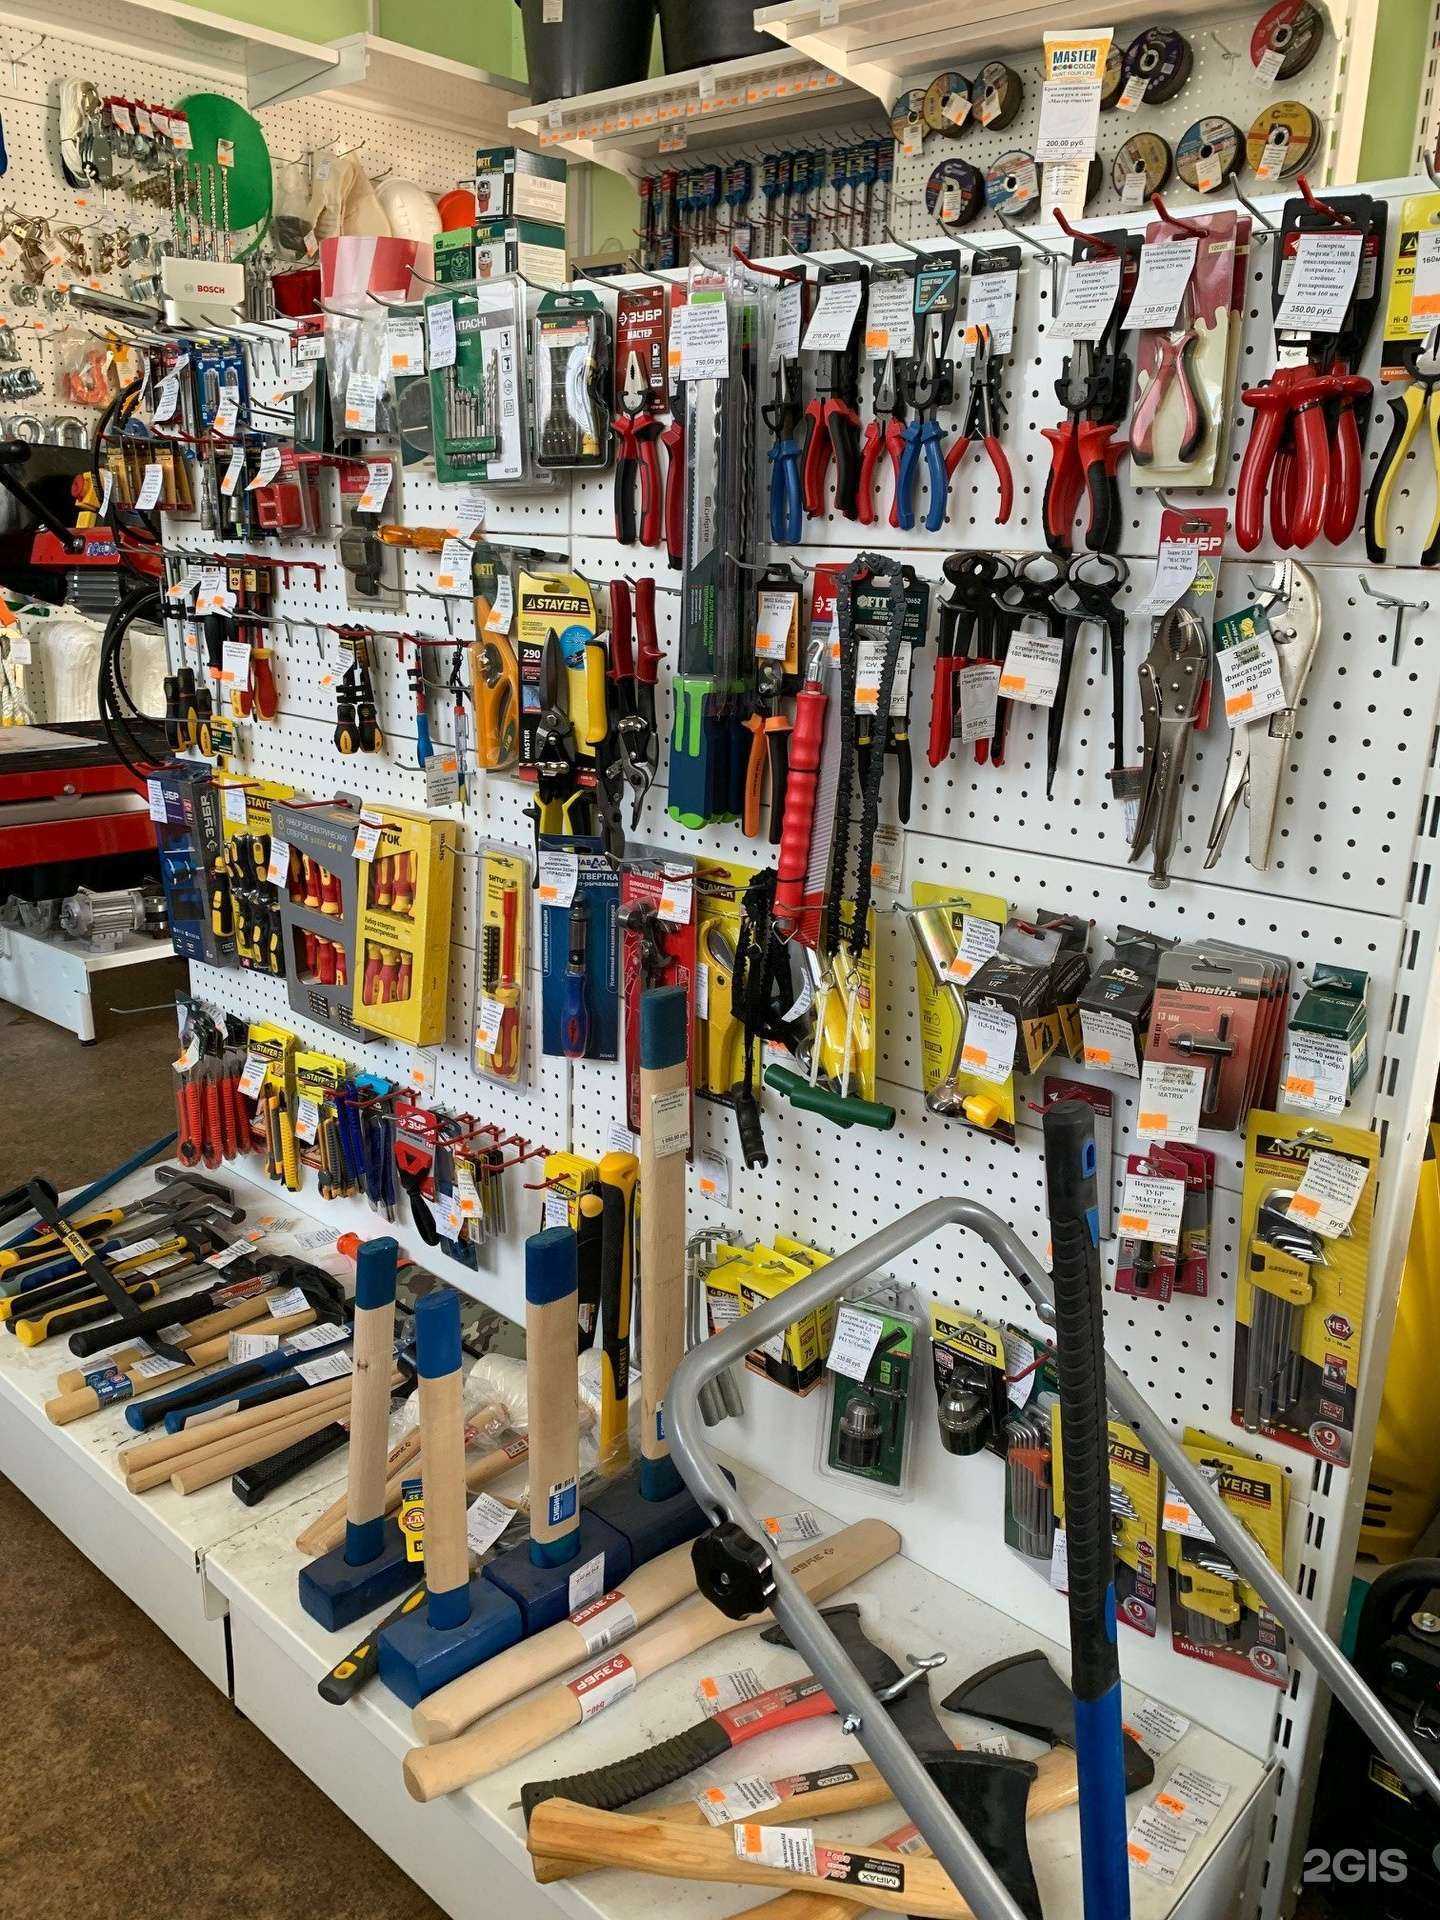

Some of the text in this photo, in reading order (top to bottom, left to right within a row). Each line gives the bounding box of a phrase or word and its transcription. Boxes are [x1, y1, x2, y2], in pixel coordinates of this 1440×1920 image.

[1053, 50, 1096, 64] MASTER
[197, 285, 225, 293] BOSCH
[629, 309, 662, 323] ЗУБР
[1290, 305, 1333, 315] 350.00 руб
[627, 329, 653, 340] МАСТЕР
[900, 337, 911, 345] руб
[536, 598, 580, 611] STAYER
[867, 596, 889, 608] FIT
[523, 649, 541, 659] 290
[1232, 668, 1271, 689] тип R3 250
[892, 696, 905, 705] руб
[1267, 689, 1280, 700] руб
[246, 799, 271, 809] STAYE
[200, 795, 215, 837] ЗУБР
[1193, 985, 1237, 998] matrix
[1158, 1092, 1184, 1100] MATRIX
[1186, 1177, 1202, 1185] БР
[1329, 1220, 1344, 1229] руб
[1328, 1319, 1350, 1333] HEX
[1325, 1431, 1337, 1445] 9
[1134, 1603, 1143, 1617] 9
[1181, 1642, 1214, 1658] MASTER
[1262, 1652, 1272, 1667] 9
[576, 1665, 614, 1691] ЗУБР
[818, 1773, 851, 1787] MIRAX
[862, 1872, 897, 1886] MIRAX
